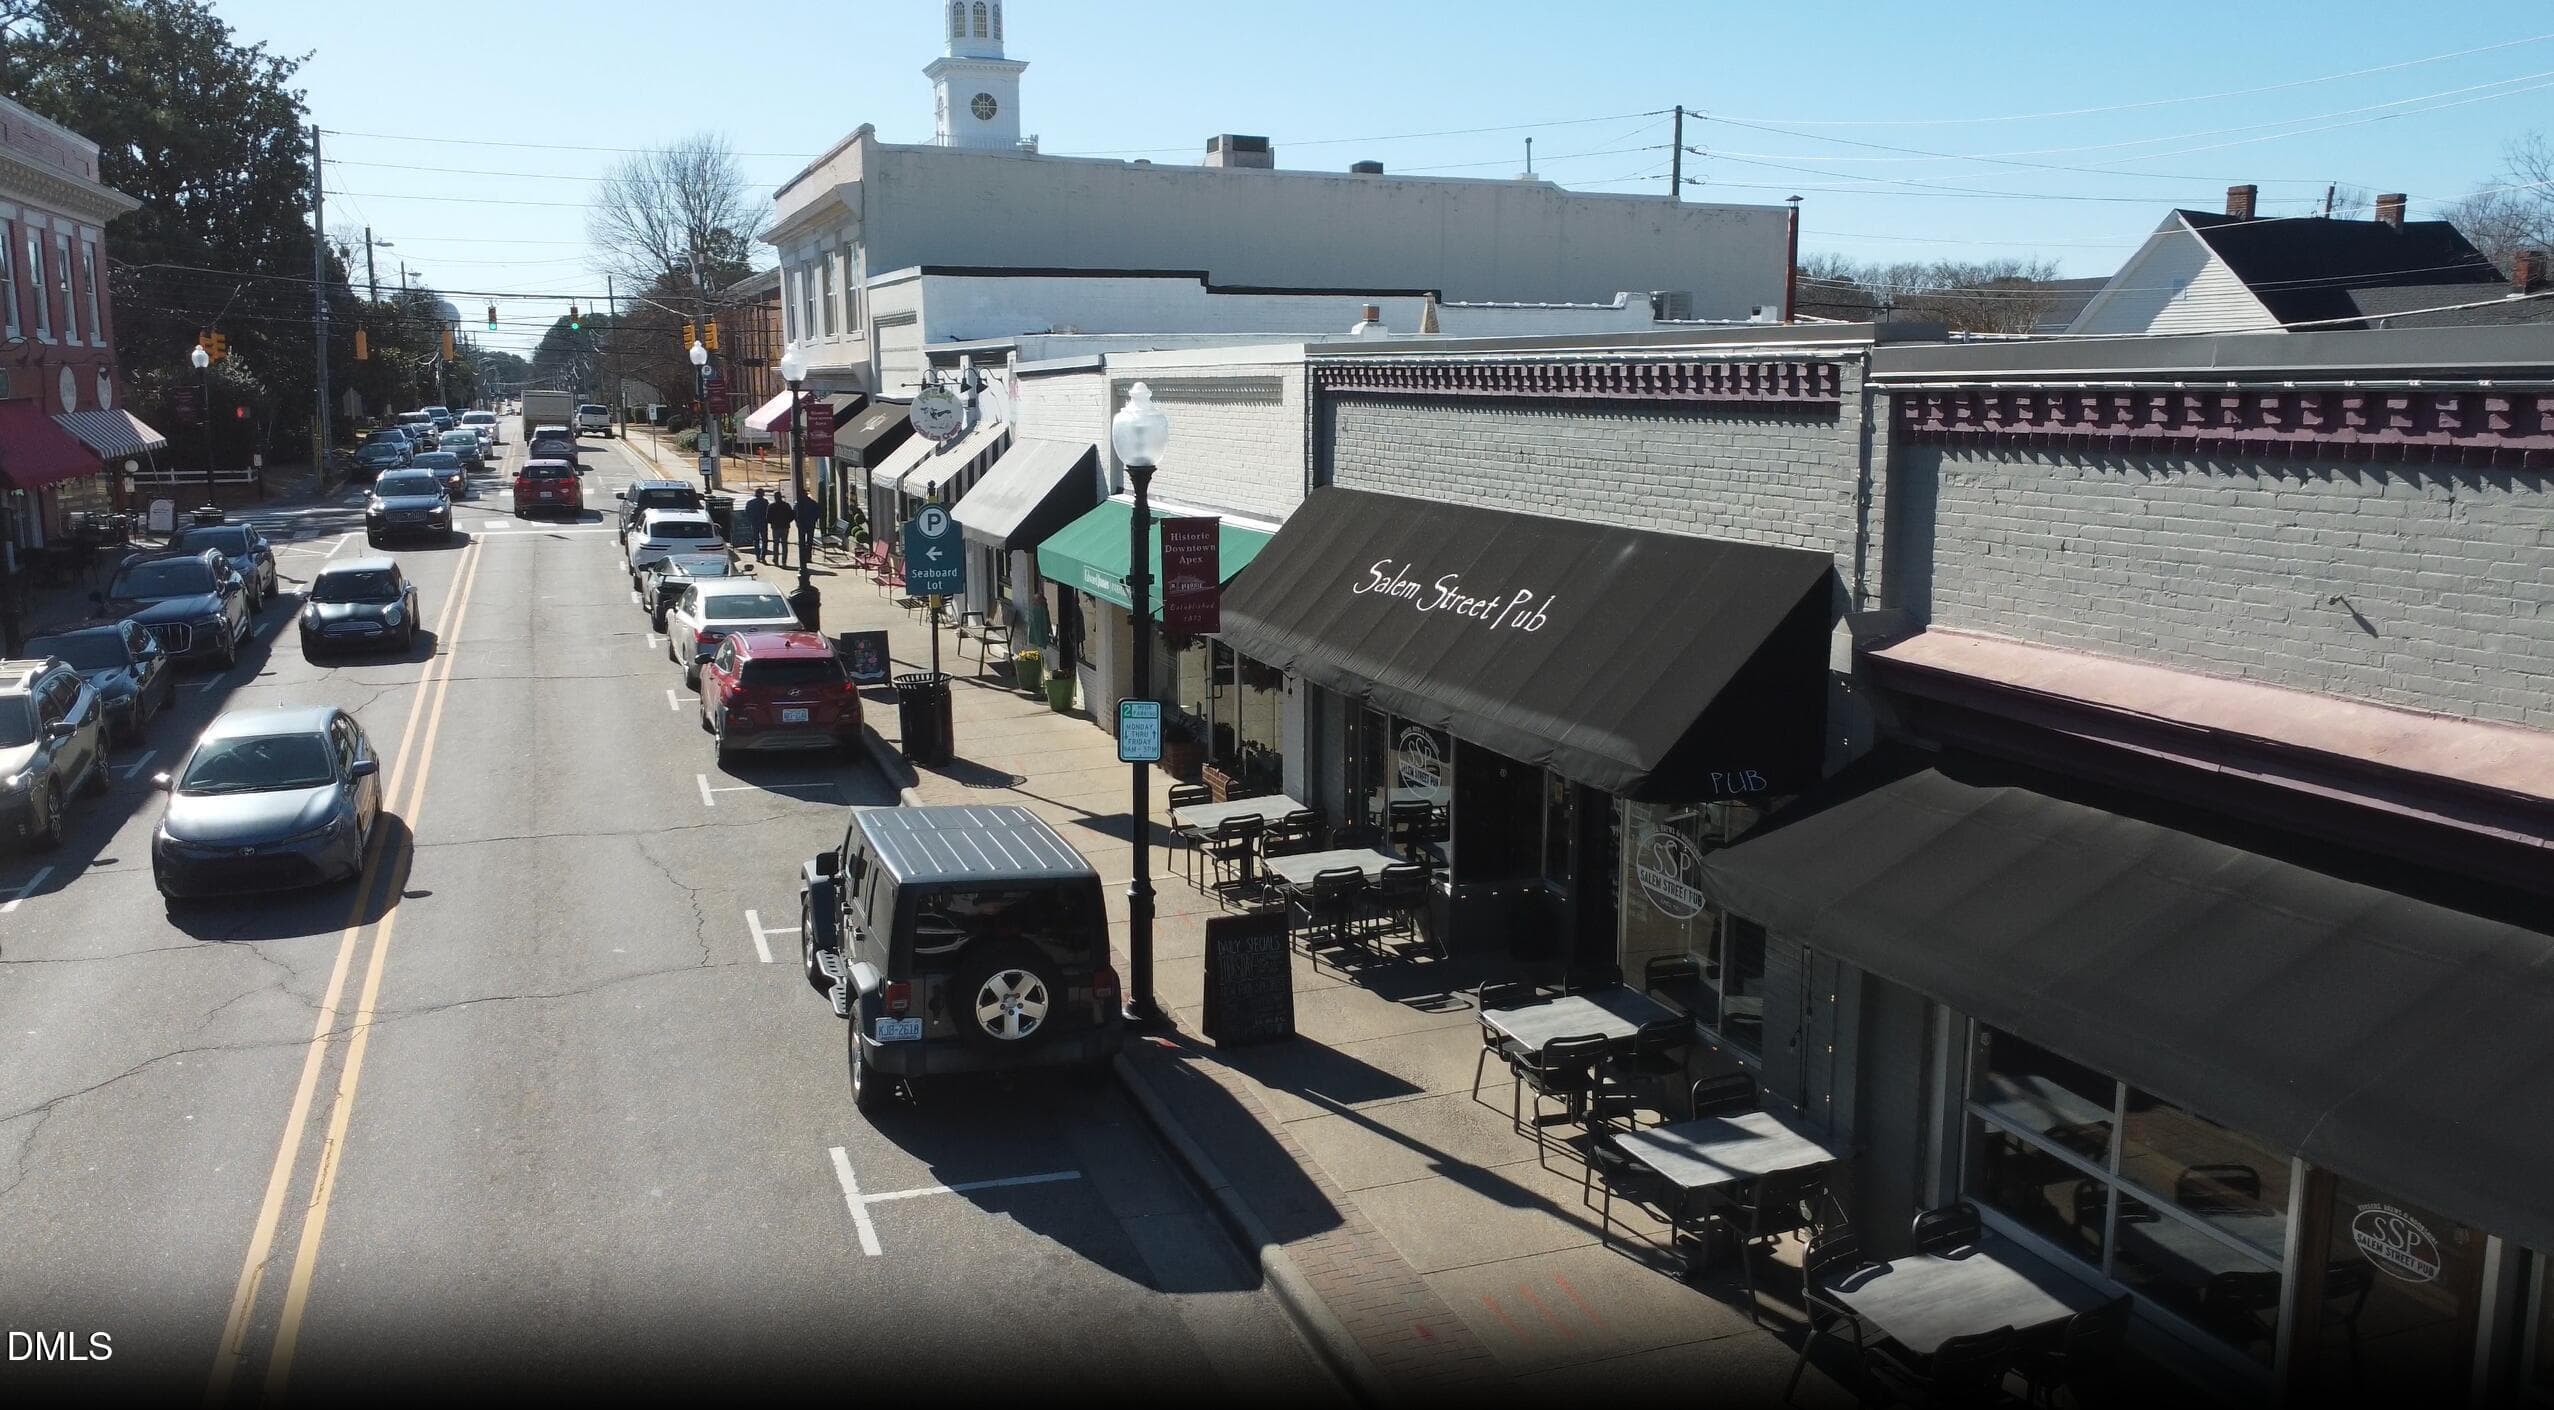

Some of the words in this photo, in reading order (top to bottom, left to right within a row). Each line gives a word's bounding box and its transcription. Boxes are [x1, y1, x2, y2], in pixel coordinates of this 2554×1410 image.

[927, 513, 942, 532] P
[1170, 532, 1210, 541] Historic
[1165, 544, 1216, 553] Downtown
[1179, 555, 1204, 565] Apex
[911, 568, 958, 578] Seaboard
[927, 580, 943, 590] Lot
[1353, 559, 1421, 599] Salem
[1416, 573, 1501, 620] Street
[1490, 588, 1556, 632] Pub
[1123, 704, 1131, 717] 2
[1408, 737, 1432, 772] SSP
[1710, 770, 1767, 794] PUB
[1653, 840, 1691, 883] SSP
[1640, 870, 1661, 889] SALEM
[1662, 881, 1689, 902] STREET
[1689, 890, 1703, 908] PUB
[2373, 1216, 2421, 1254] SSP
[2357, 1233, 2384, 1253] SALEM
[2385, 1246, 2416, 1267] STREET
[2417, 1262, 2434, 1277] PUB
